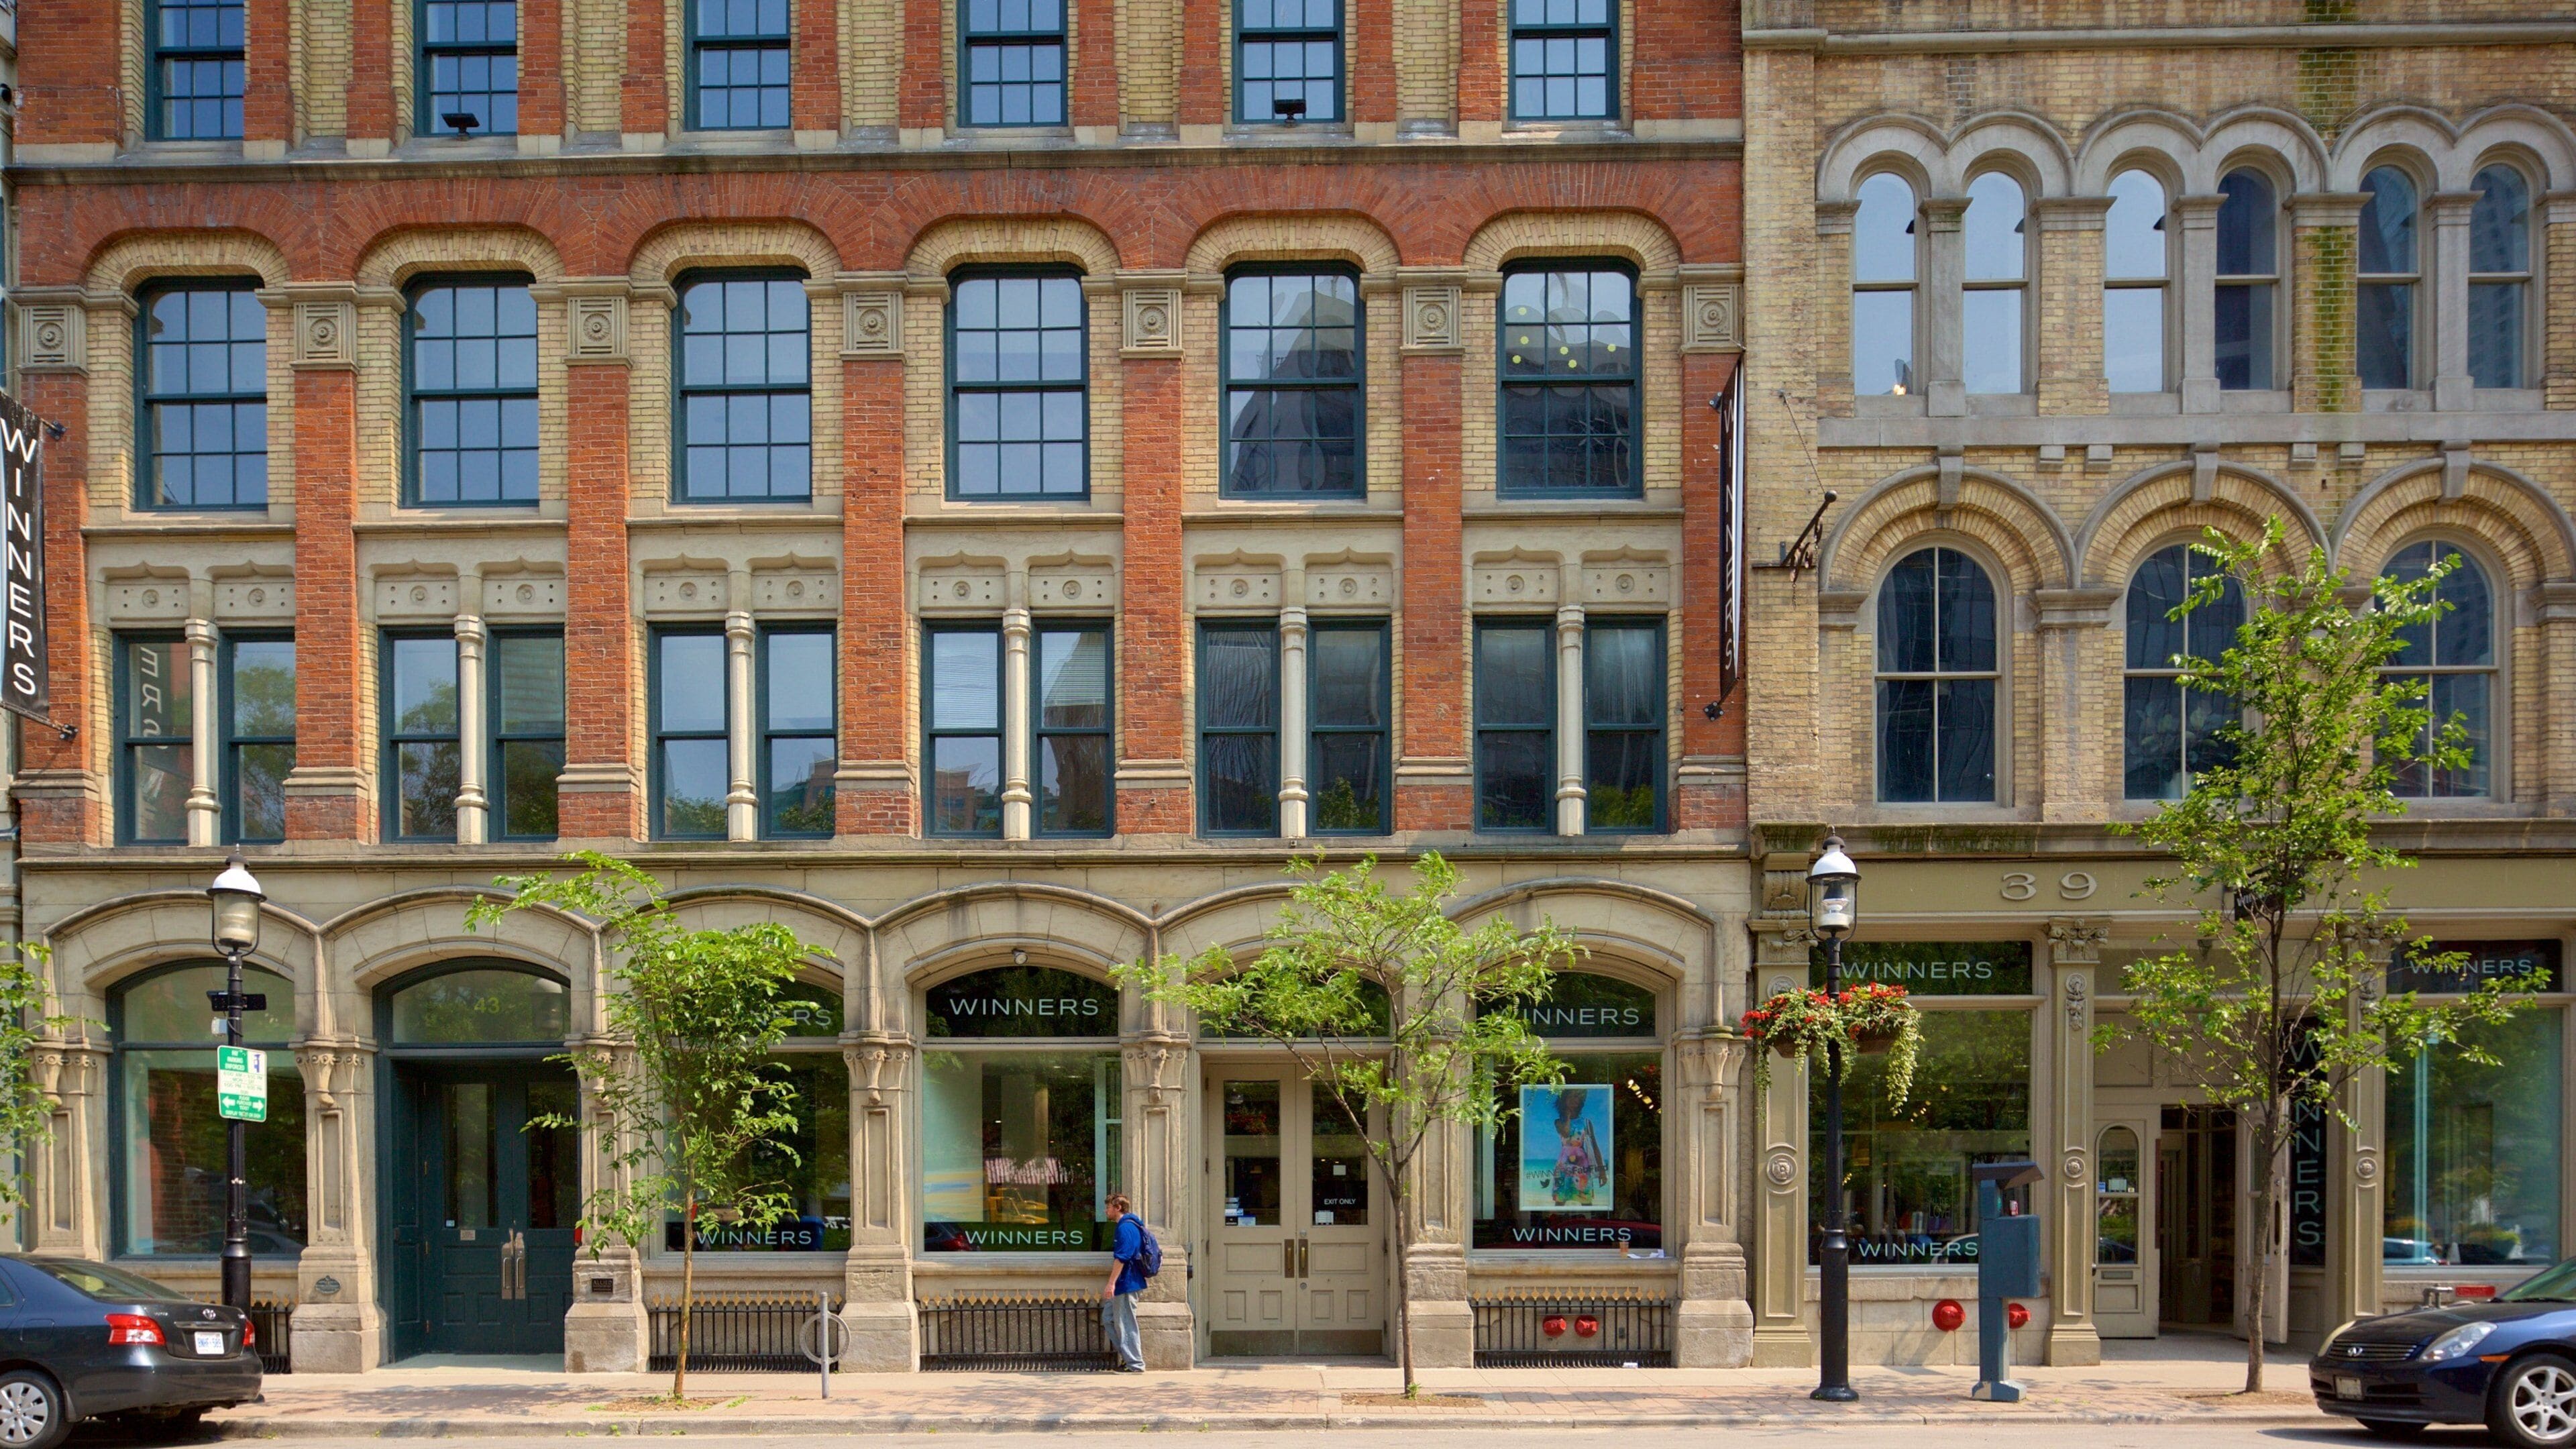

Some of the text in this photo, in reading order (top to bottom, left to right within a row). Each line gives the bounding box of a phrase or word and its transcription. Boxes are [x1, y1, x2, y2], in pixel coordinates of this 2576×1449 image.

[0, 417, 37, 695] WINNERS
[2000, 871, 2098, 902] 39
[1841, 961, 1992, 979] WINNERS
[474, 997, 500, 1014] 43
[949, 998, 1099, 1016] WINNERS
[1491, 1008, 1640, 1025] INNERS
[696, 1231, 812, 1244] WINNERS
[965, 1230, 1083, 1244] WINNERS
[1513, 1228, 1631, 1242] WINNERS
[1858, 1242, 1978, 1256] WINNERS
